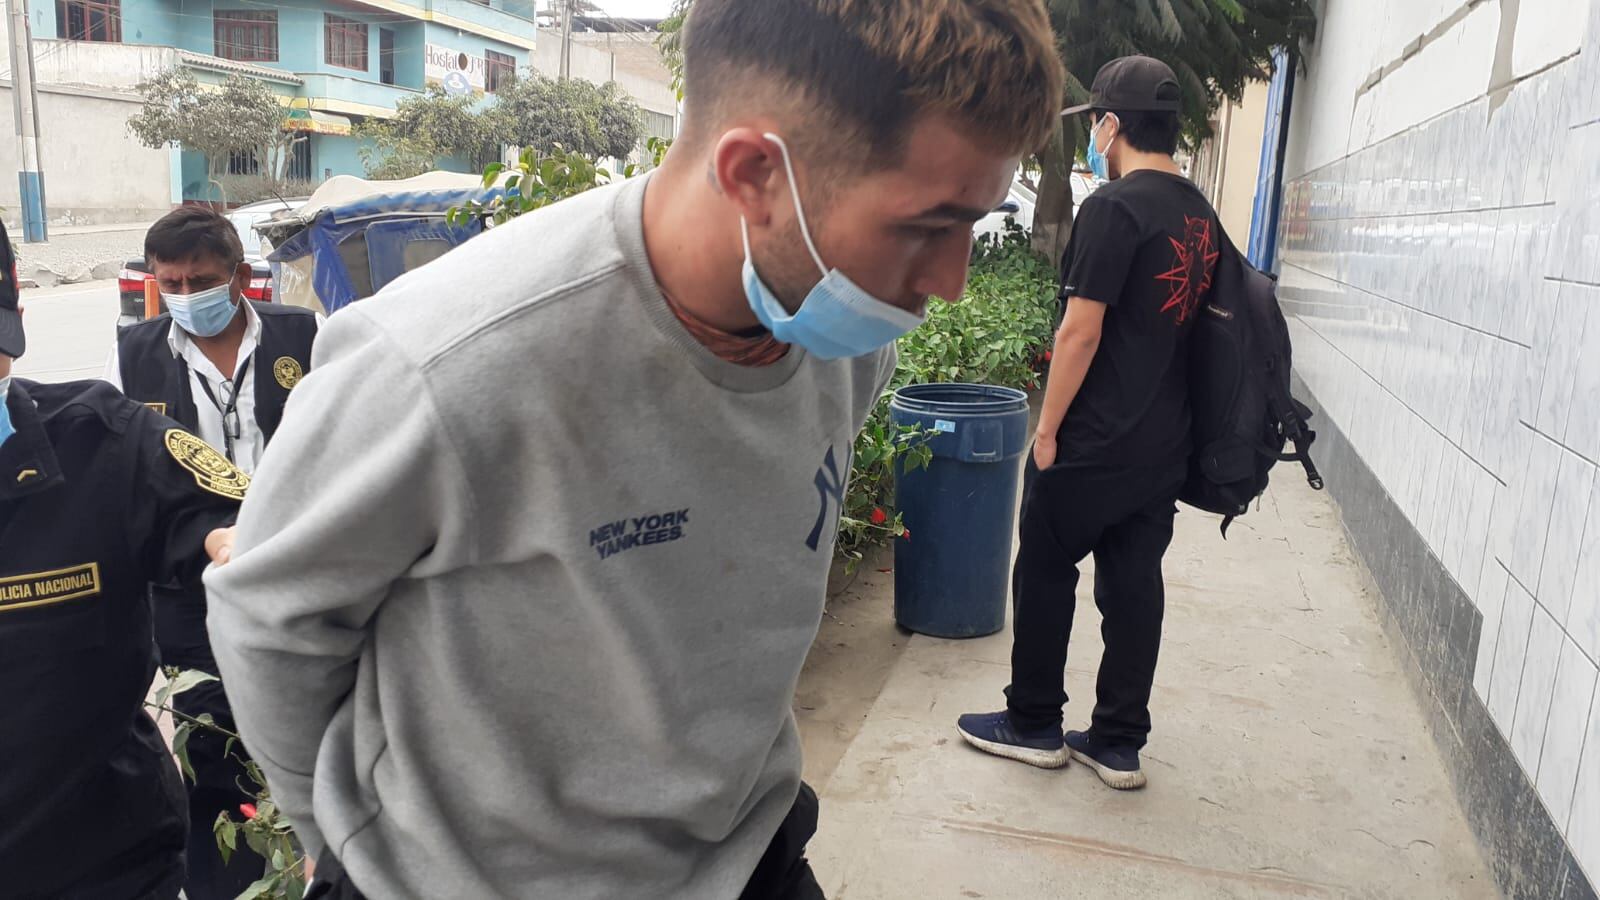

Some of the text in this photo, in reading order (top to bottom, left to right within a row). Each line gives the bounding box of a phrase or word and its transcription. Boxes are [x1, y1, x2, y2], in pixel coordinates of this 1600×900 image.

[425, 44, 459, 72] Hostal
[590, 508, 689, 547] NEW YORK
[596, 526, 683, 560] YANKEES
[34, 572, 94, 596] NACIONAL
